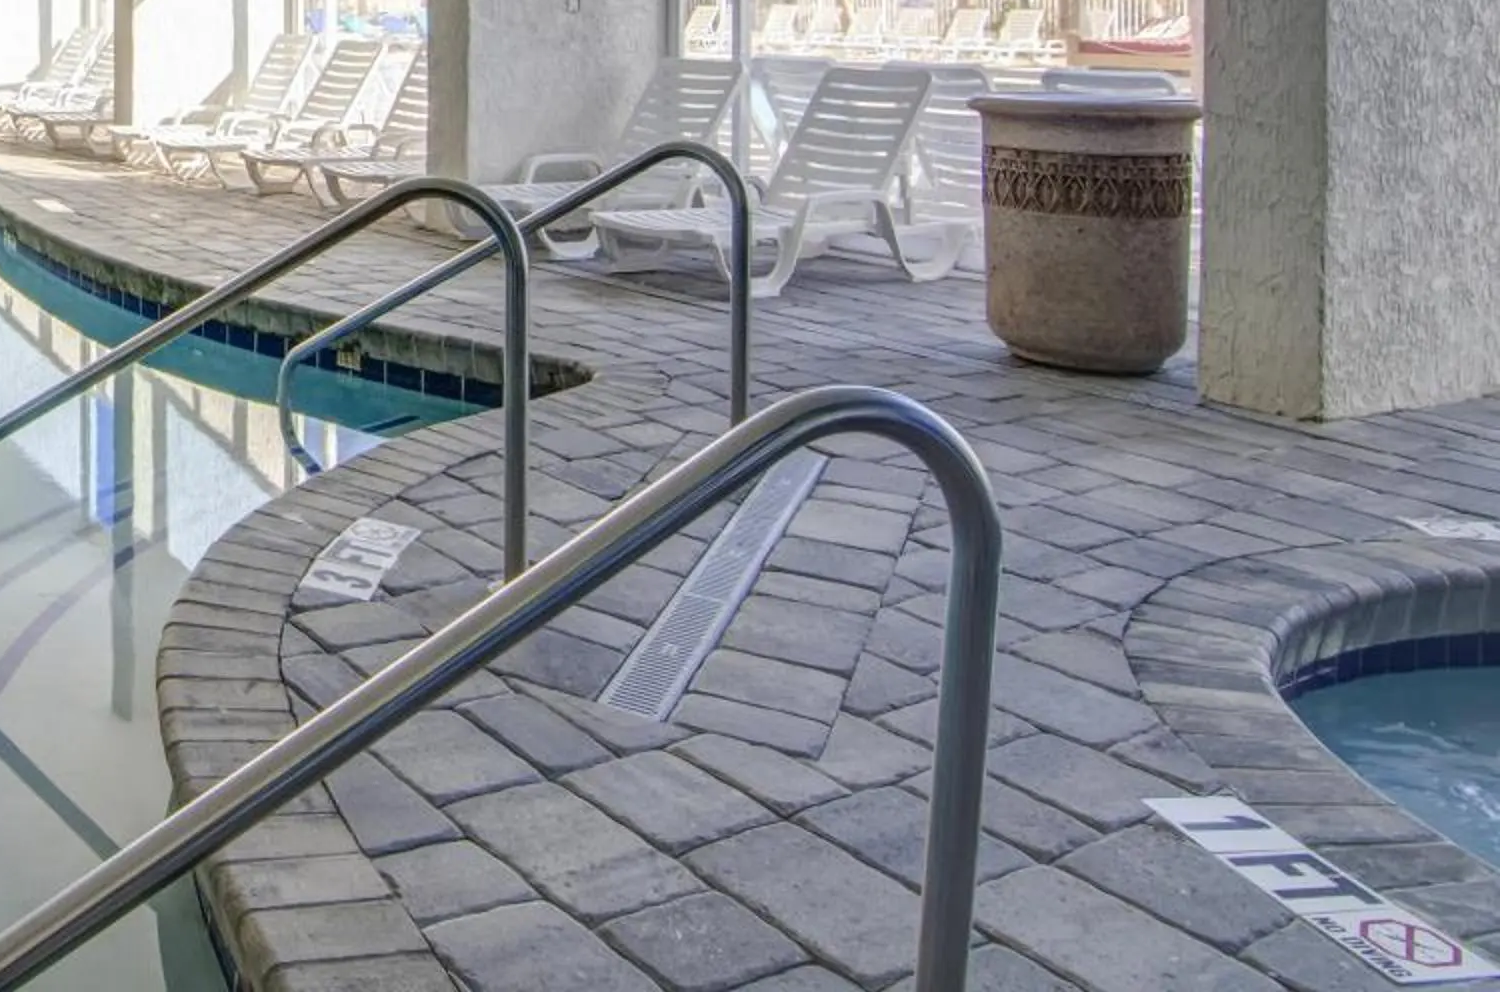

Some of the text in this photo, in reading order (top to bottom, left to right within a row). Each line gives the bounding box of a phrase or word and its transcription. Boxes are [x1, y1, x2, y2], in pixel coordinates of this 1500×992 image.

[313, 539, 393, 589] 3 FT
[1181, 815, 1384, 905] 1 FT
[1311, 917, 1413, 977] NO DIVING
